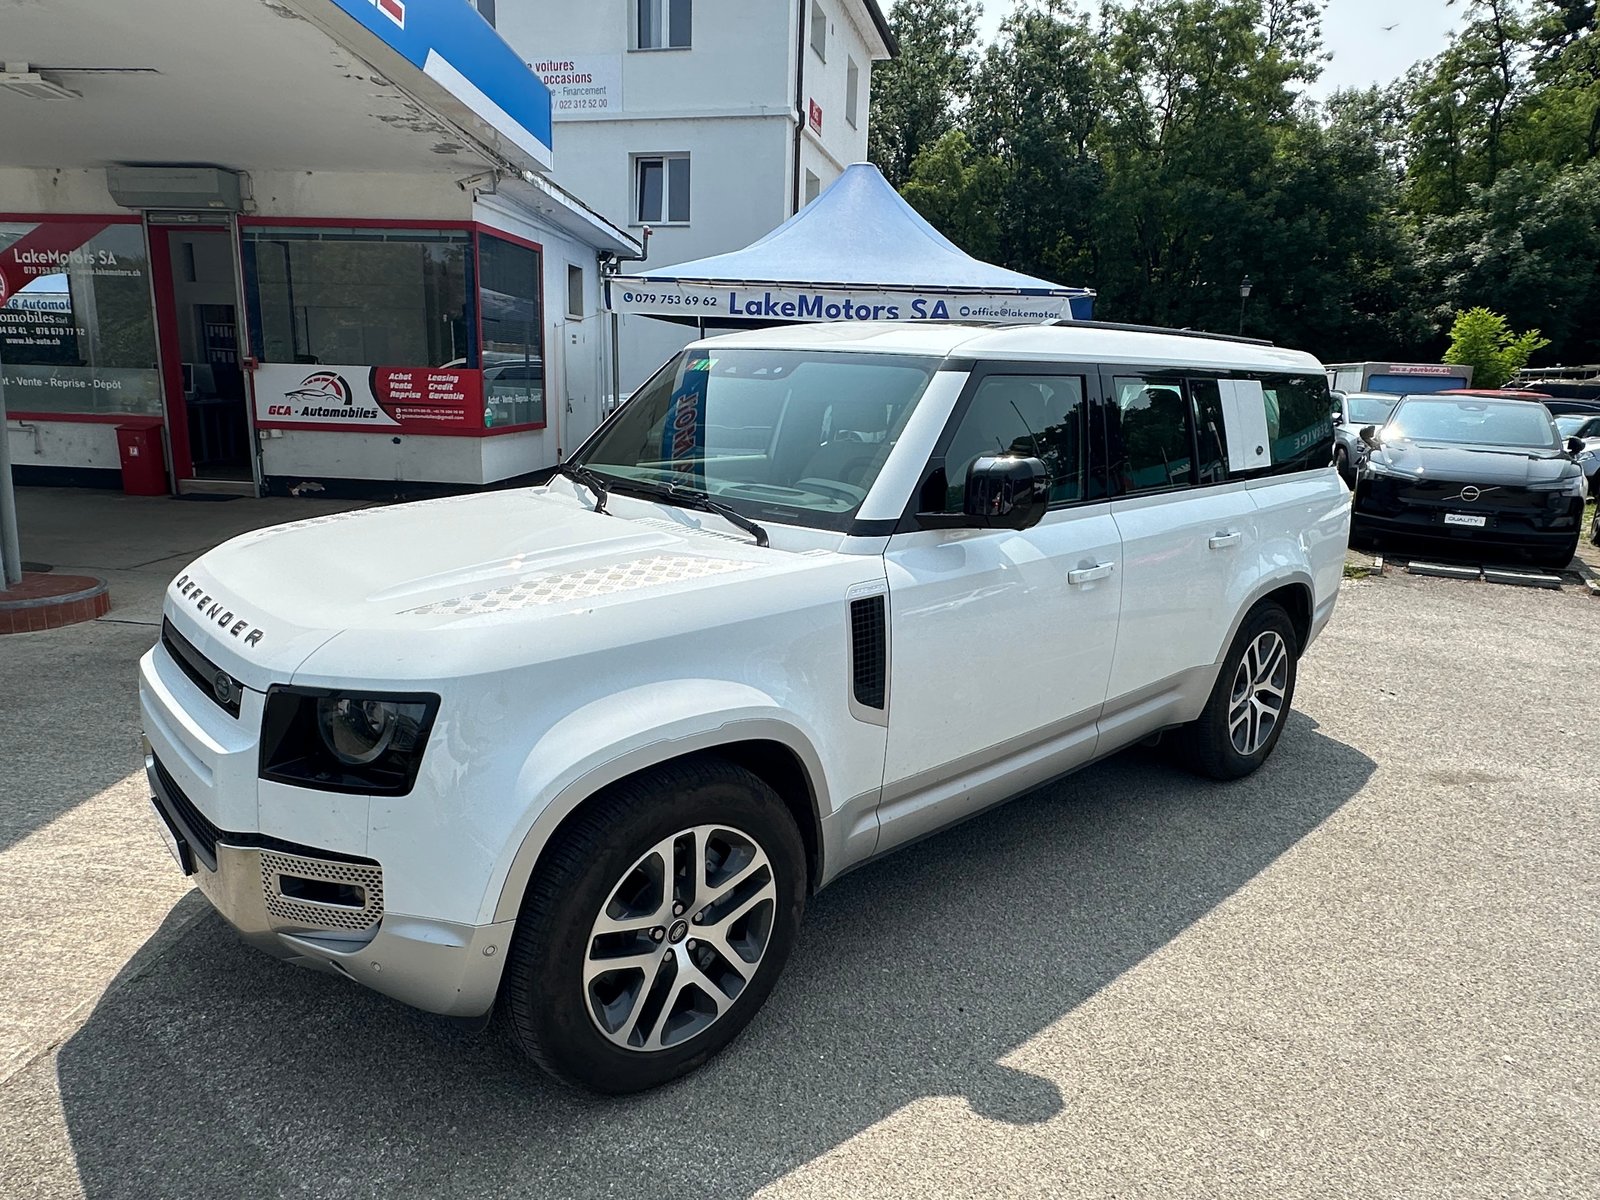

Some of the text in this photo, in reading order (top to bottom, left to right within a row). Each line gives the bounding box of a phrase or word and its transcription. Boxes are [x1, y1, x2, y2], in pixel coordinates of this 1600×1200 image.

[535, 60, 575, 72] voitures
[543, 72, 592, 84] occasions
[563, 86, 607, 96] Financement
[560, 100, 572, 109] 022
[573, 99, 587, 108] 312
[588, 99, 597, 108] 52
[598, 98, 608, 108] 00
[14, 248, 117, 265] LakeMotors SA
[635, 293, 717, 306] 079 753 69 62
[729, 292, 950, 320] LakeMotors SA
[971, 307, 1062, 319] office@lakemotor
[76, 328, 85, 336] 12
[388, 372, 412, 380] Achat
[427, 374, 459, 383] Leasing
[16, 377, 42, 387] Vente
[50, 378, 86, 389] Reprise
[93, 379, 121, 391] Dépôt
[390, 381, 413, 389] Vente
[389, 391, 421, 399] Reprise
[428, 392, 464, 400] Garantie
[268, 405, 292, 416] GCA
[300, 407, 378, 419] Automobiles
[176, 574, 264, 648] DEFENDER
